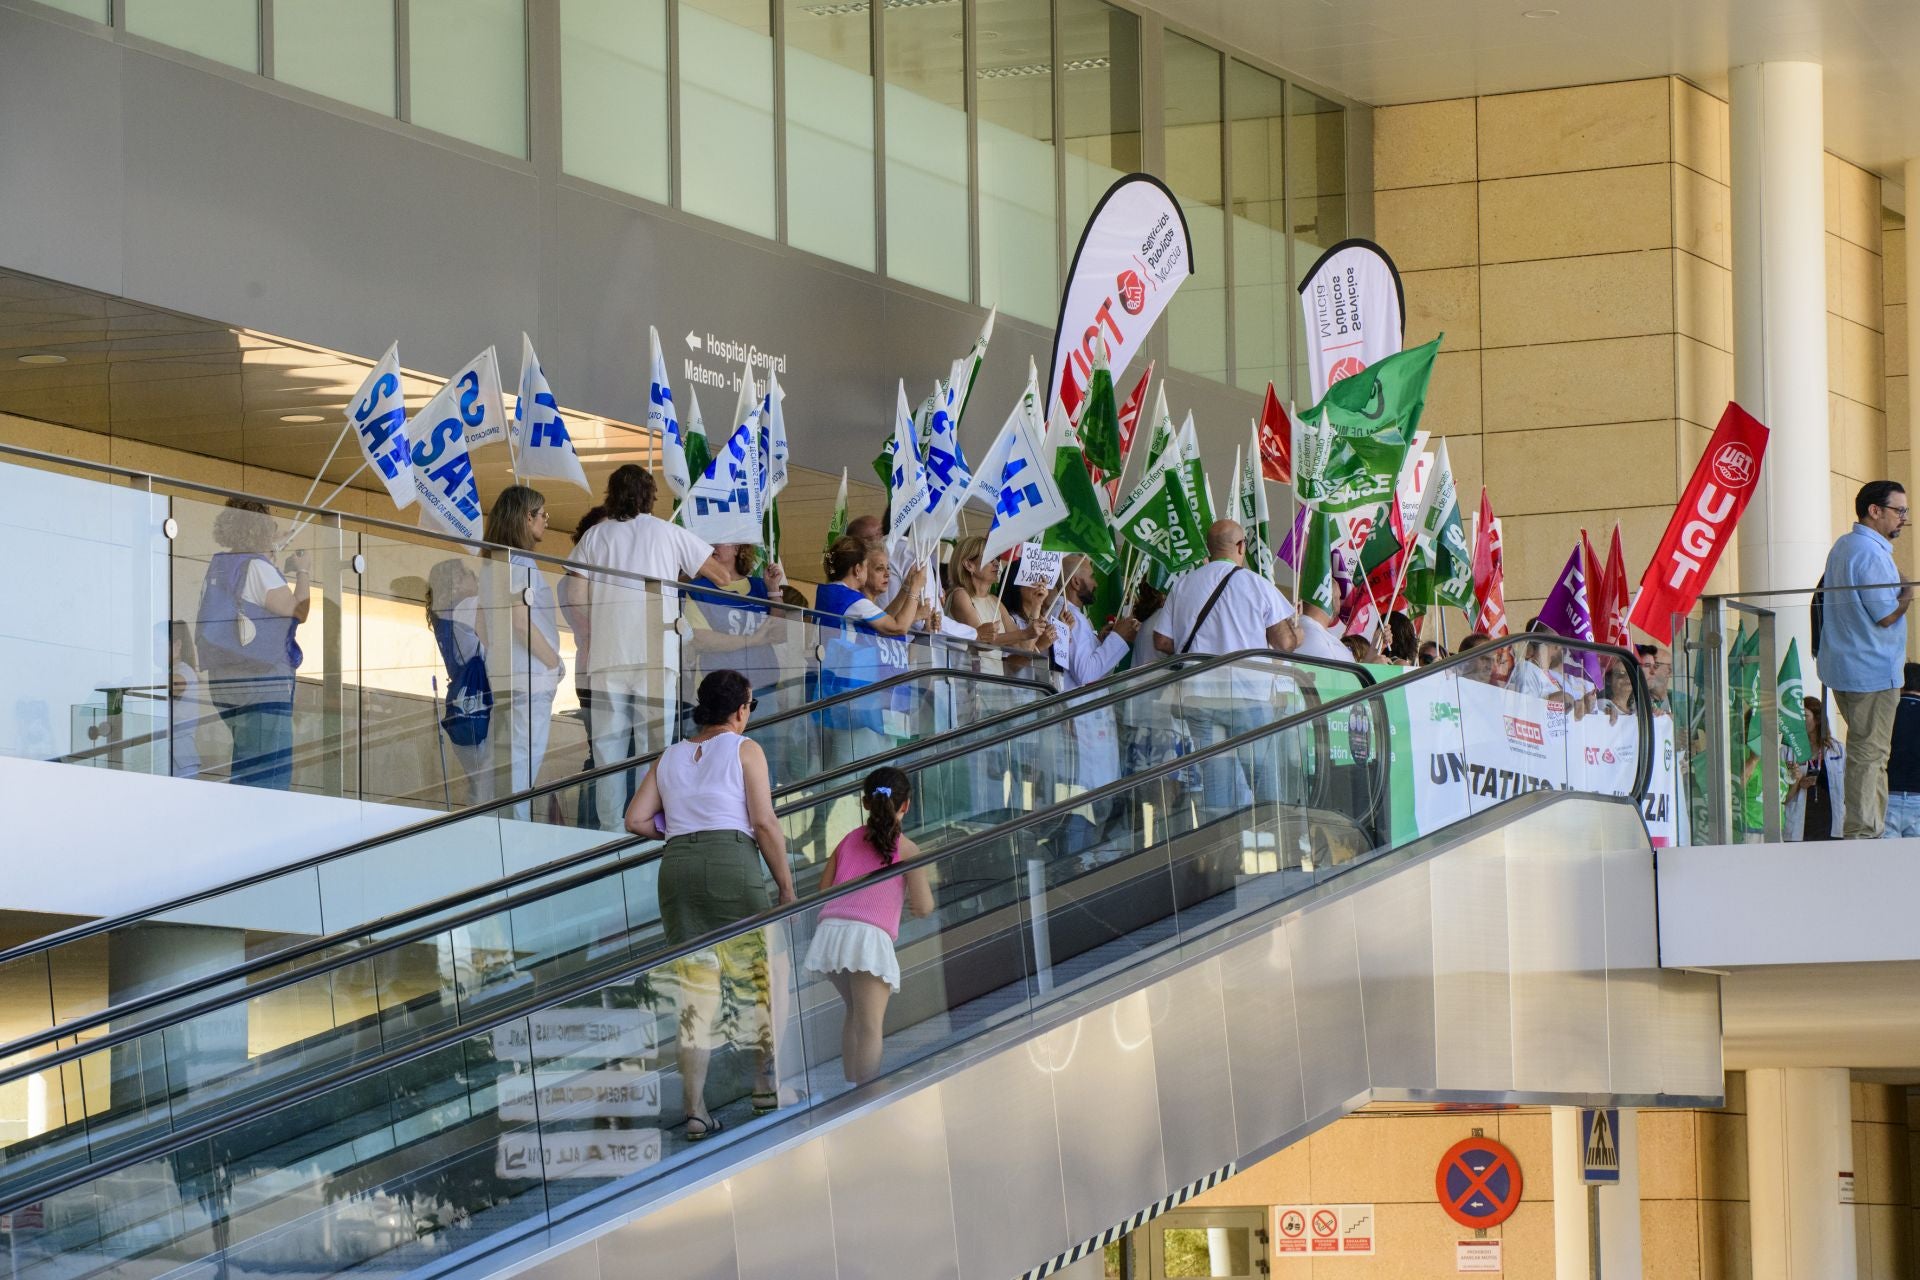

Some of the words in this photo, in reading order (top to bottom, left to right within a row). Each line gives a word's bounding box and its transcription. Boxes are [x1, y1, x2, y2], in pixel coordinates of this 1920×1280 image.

[1141, 212, 1170, 256] Servicios
[1154, 245, 1182, 284] Murcia
[707, 332, 747, 364] Hospital
[749, 345, 787, 374] General
[684, 358, 725, 389] Materno
[1719, 446, 1753, 474] UGT
[1670, 482, 1737, 590] UGT
